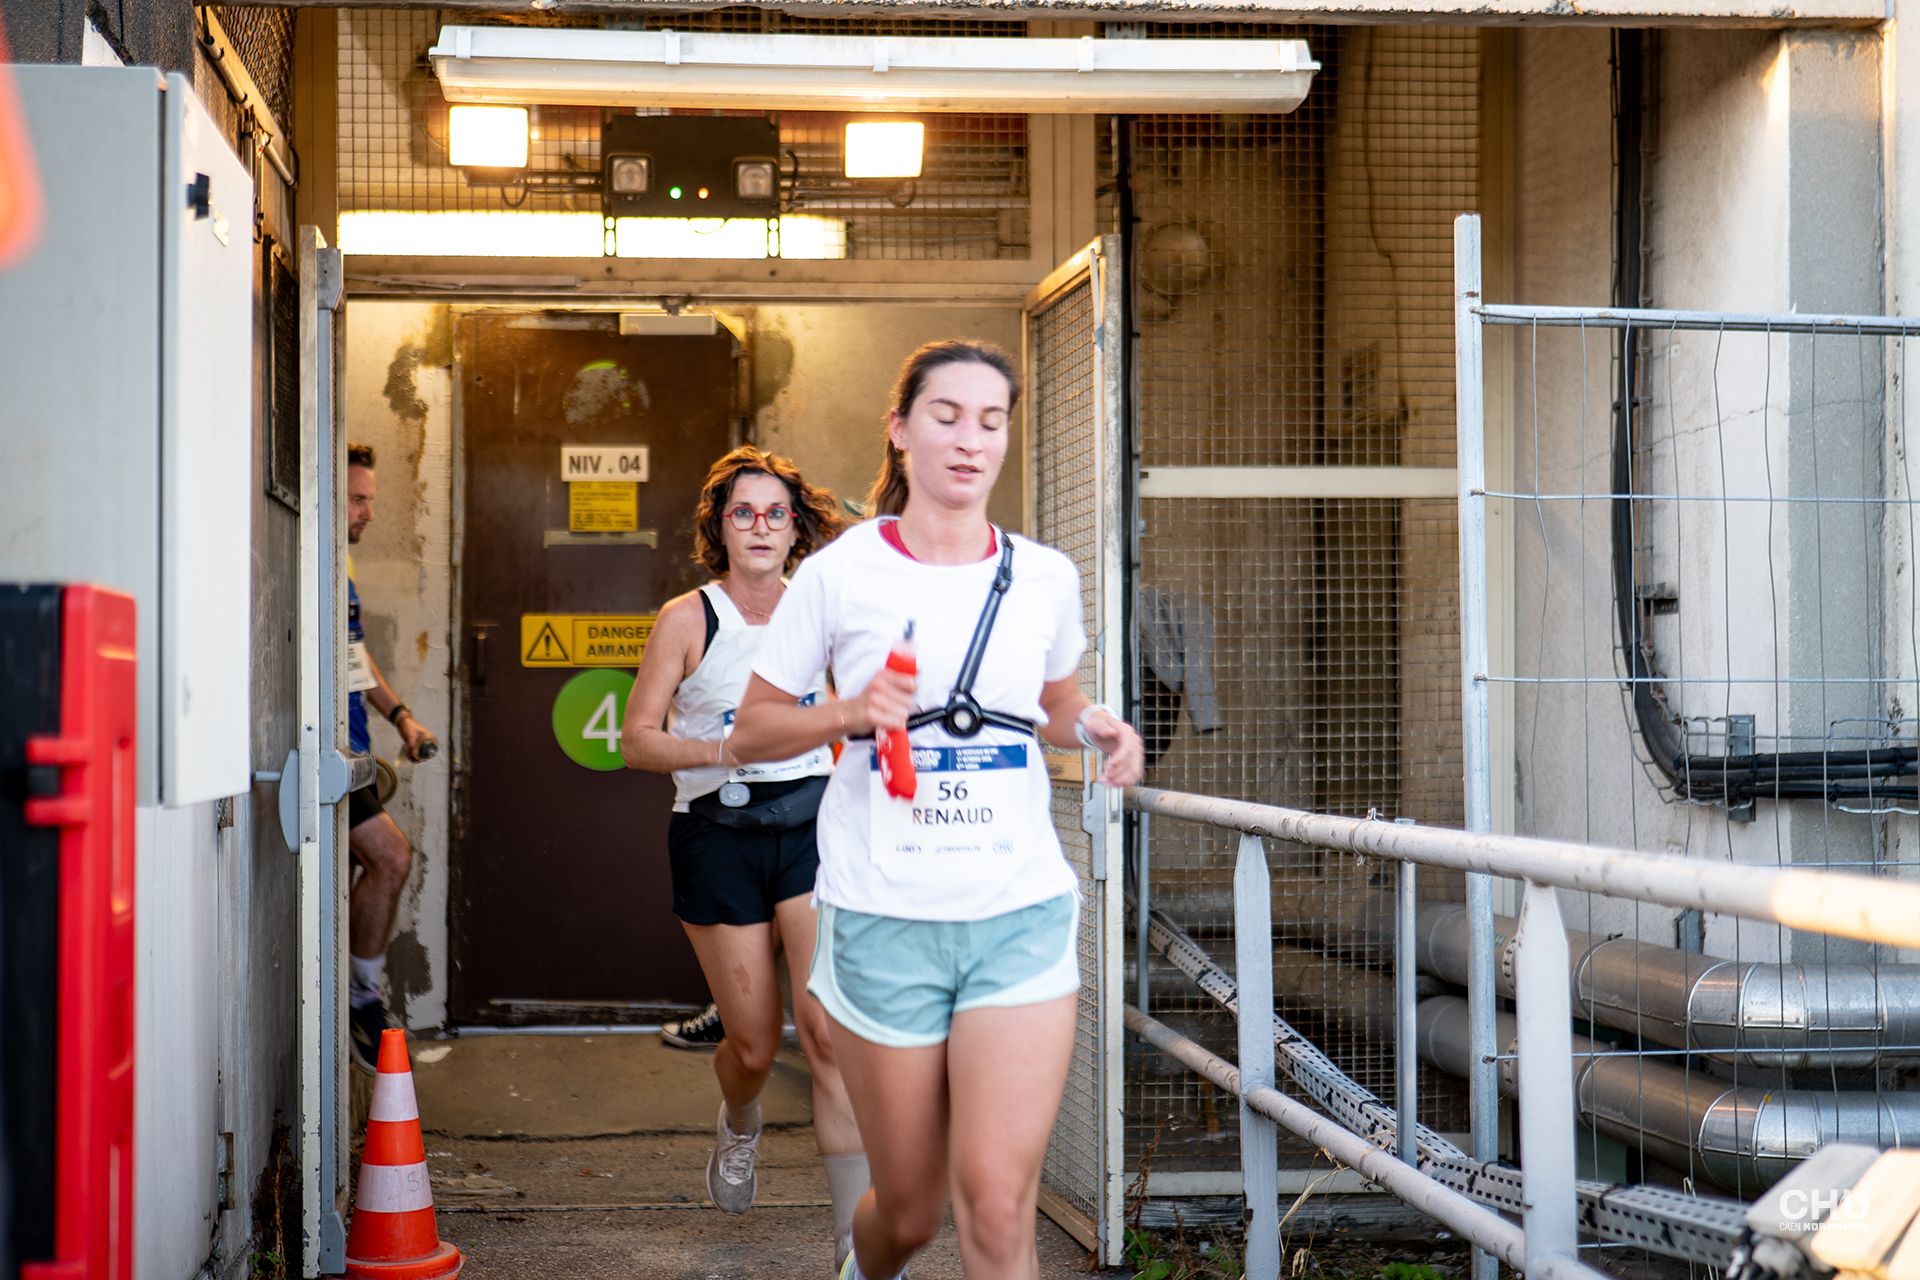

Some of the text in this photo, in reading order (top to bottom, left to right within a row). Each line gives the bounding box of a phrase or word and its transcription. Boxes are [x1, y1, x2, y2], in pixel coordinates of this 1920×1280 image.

[569, 455, 602, 474] NIV
[619, 455, 641, 474] 04
[587, 644, 648, 658] AMIANT
[582, 693, 622, 753] 4
[937, 780, 968, 802] 56
[912, 807, 993, 825] RENAUD
